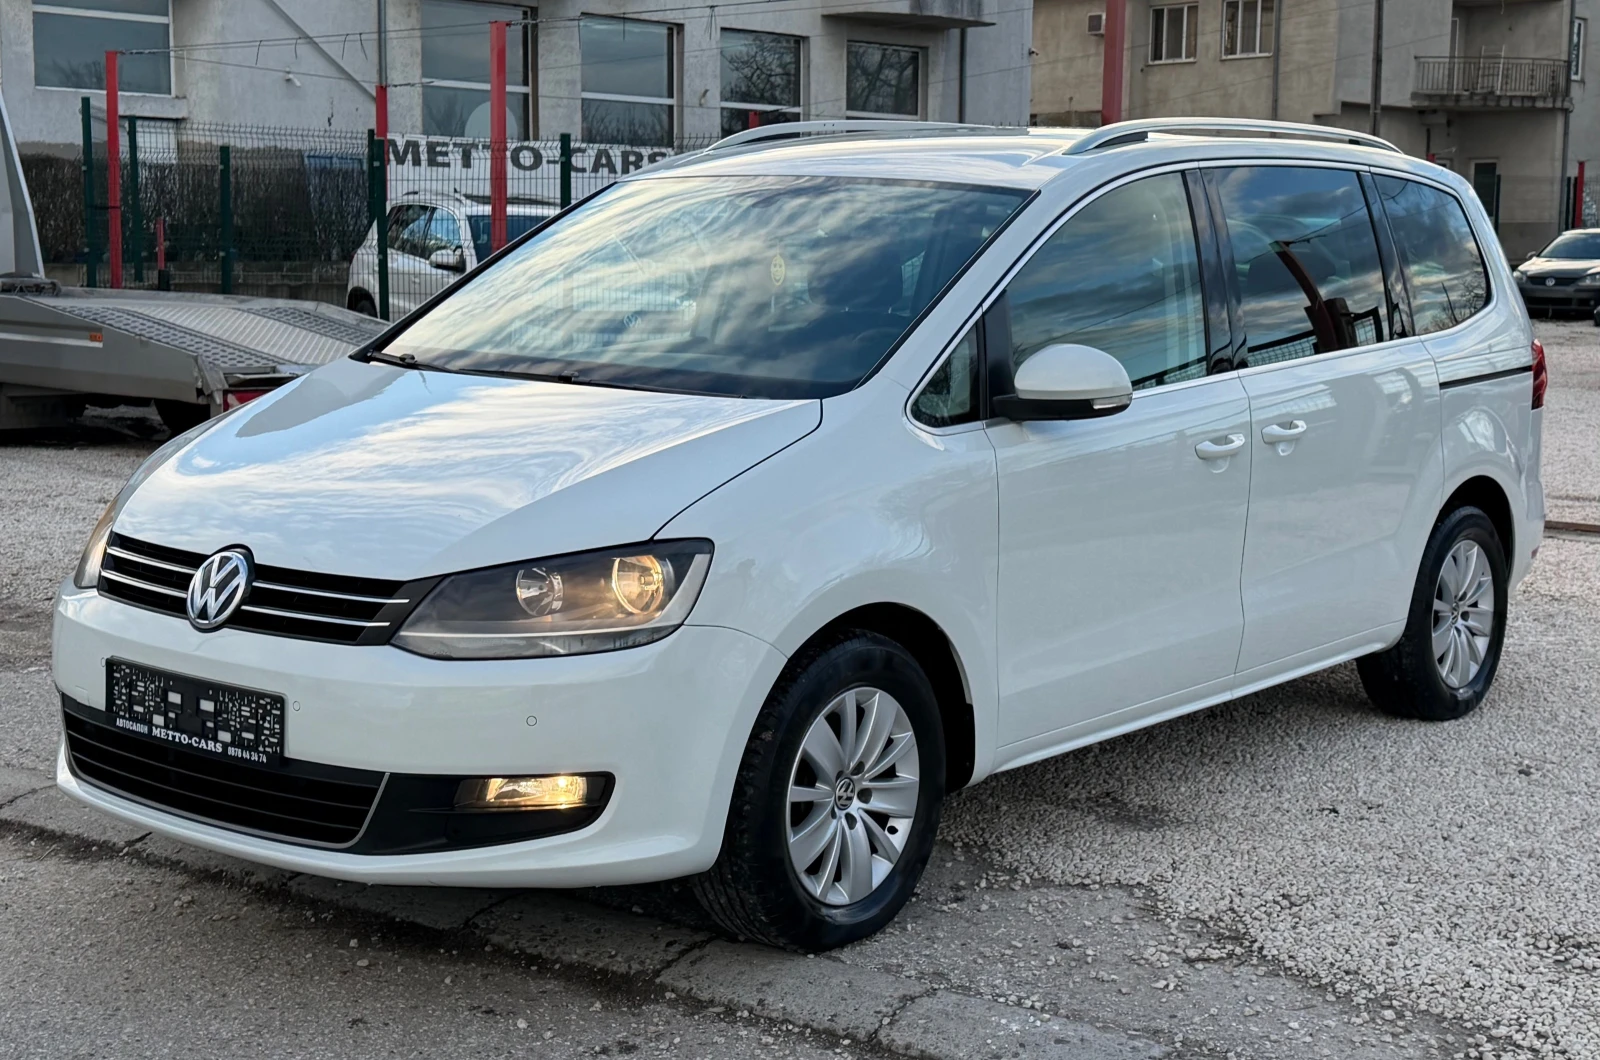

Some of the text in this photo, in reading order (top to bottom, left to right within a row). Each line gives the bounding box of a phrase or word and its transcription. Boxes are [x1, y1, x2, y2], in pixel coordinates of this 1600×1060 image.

[187, 551, 248, 629] VW
[151, 726, 223, 753] METTO-CARS
[259, 753, 267, 764] 74
